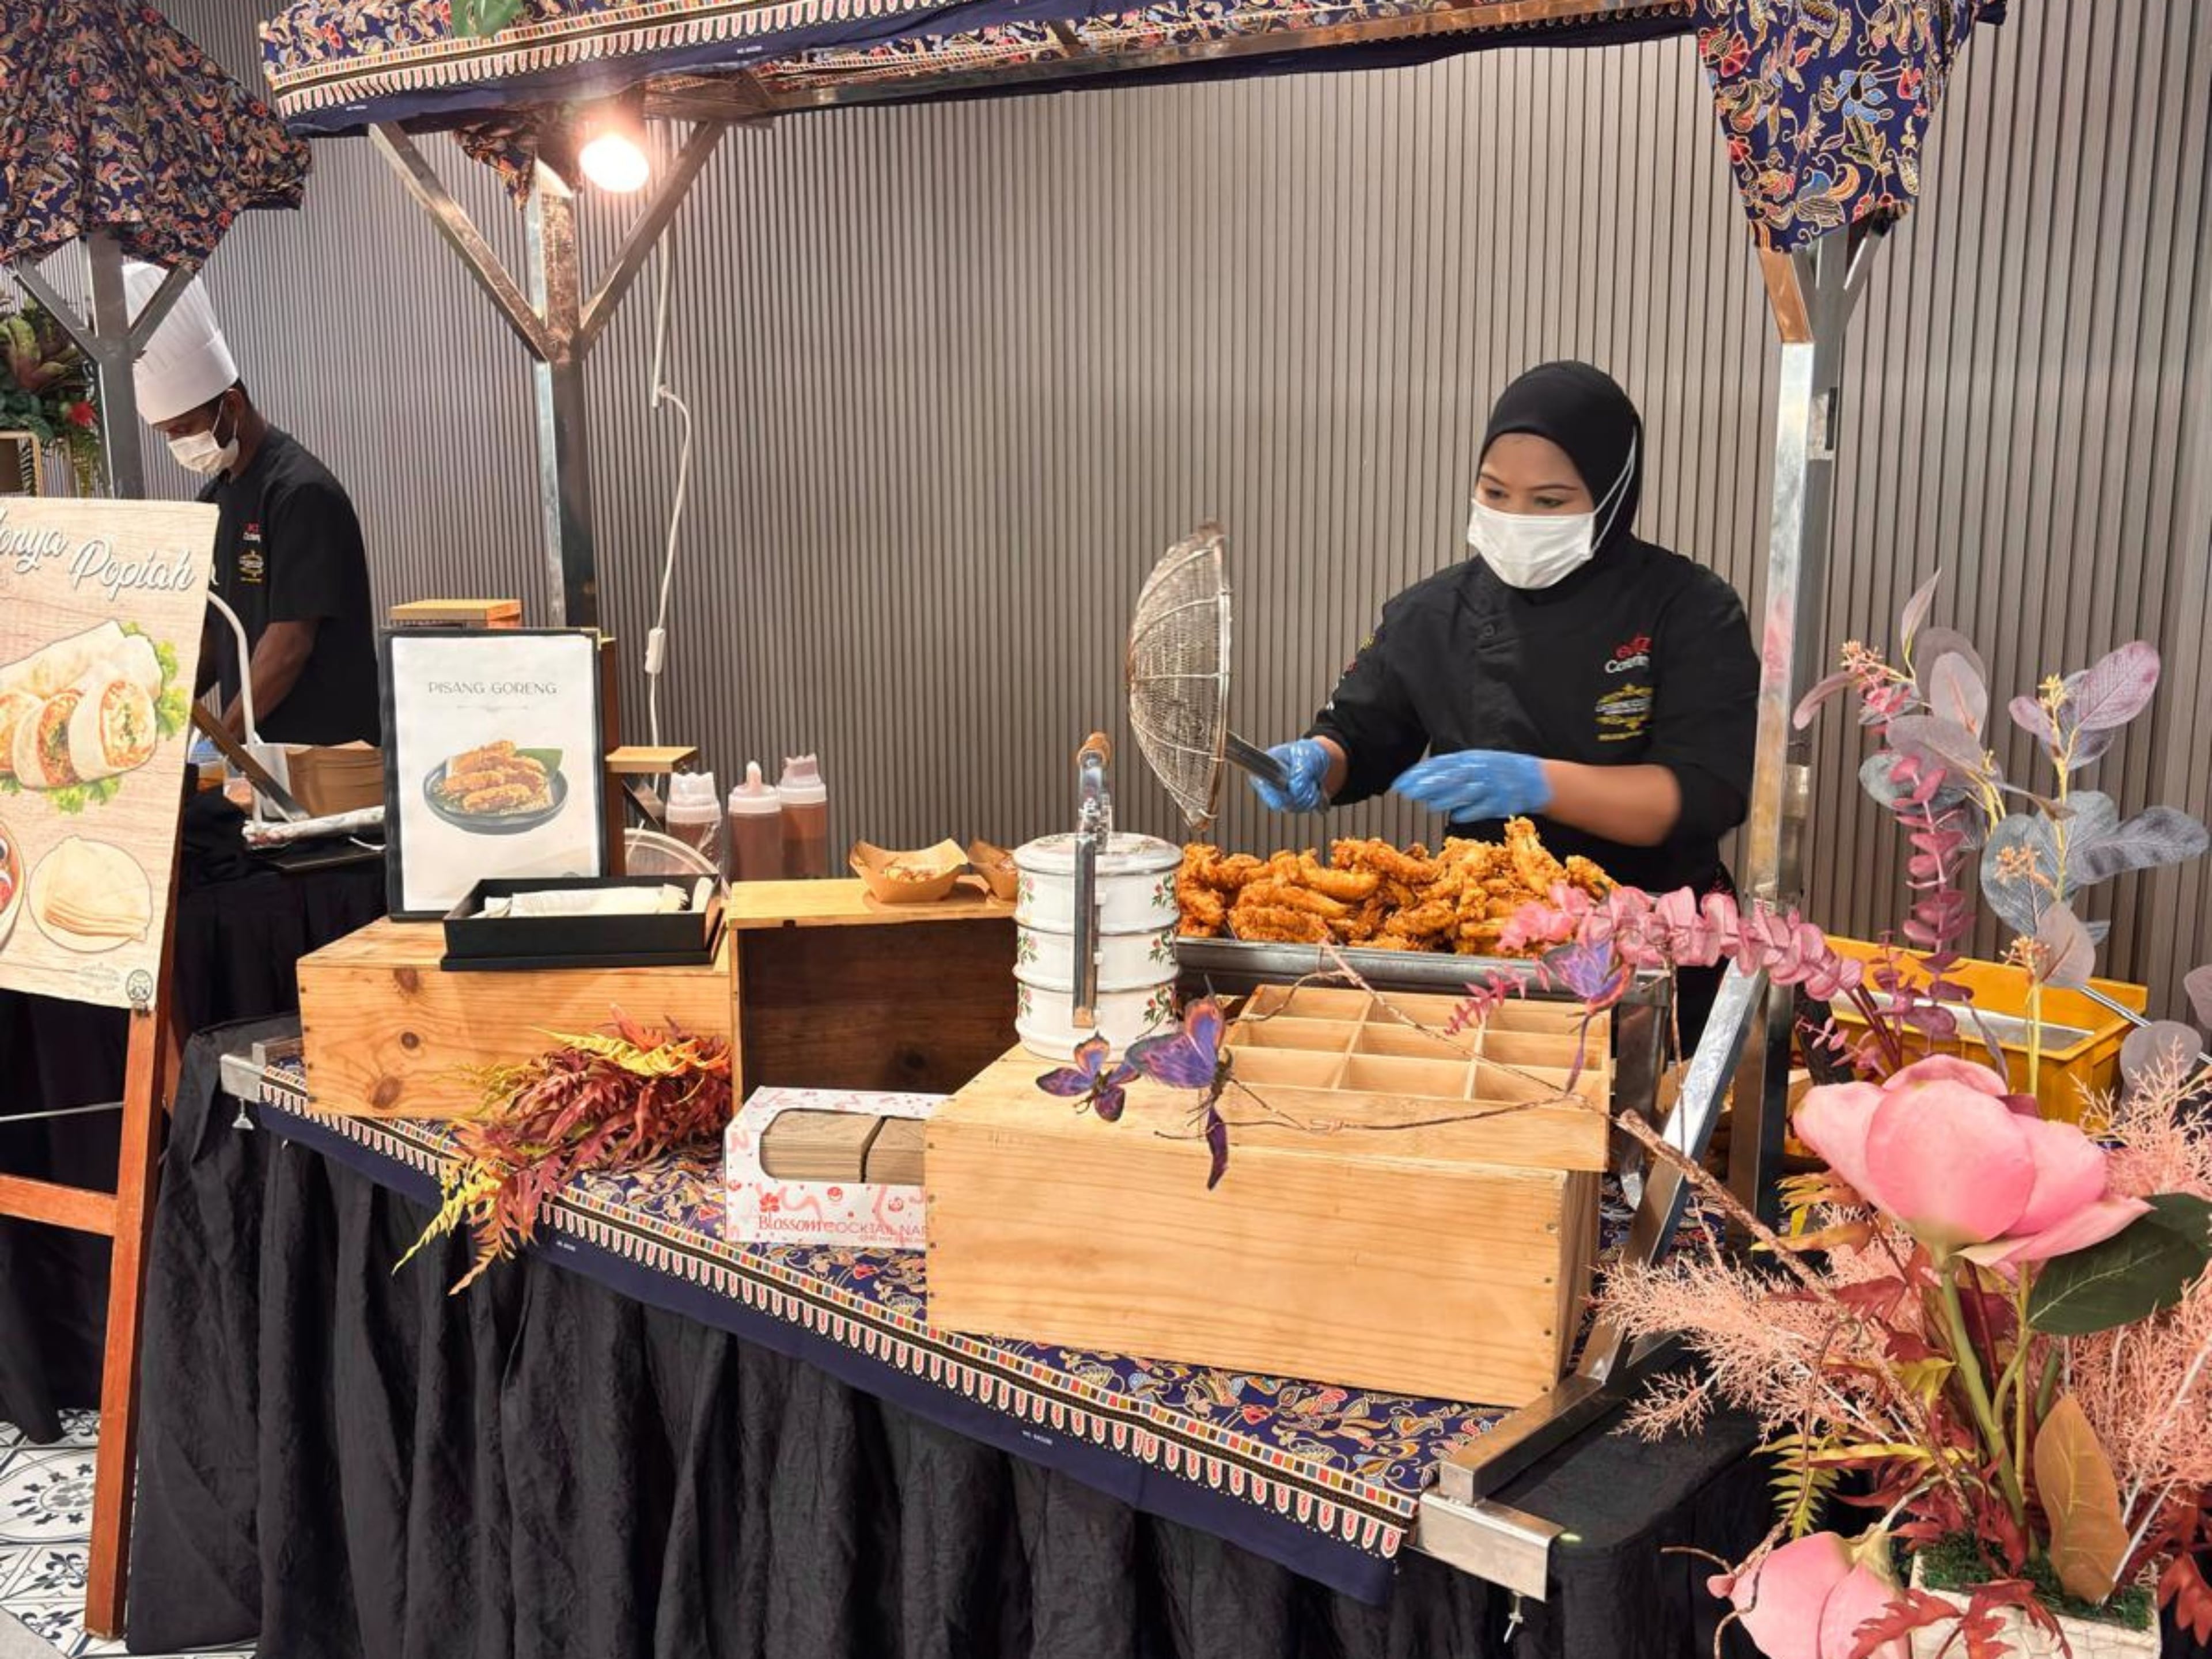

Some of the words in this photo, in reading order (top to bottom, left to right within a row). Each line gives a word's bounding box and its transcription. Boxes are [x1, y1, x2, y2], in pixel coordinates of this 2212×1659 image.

[0, 505, 69, 575] onya
[69, 537, 197, 602] Popiah
[429, 681, 486, 694] PISANG
[491, 681, 558, 695] GORENG
[758, 1213, 821, 1232] Blossom
